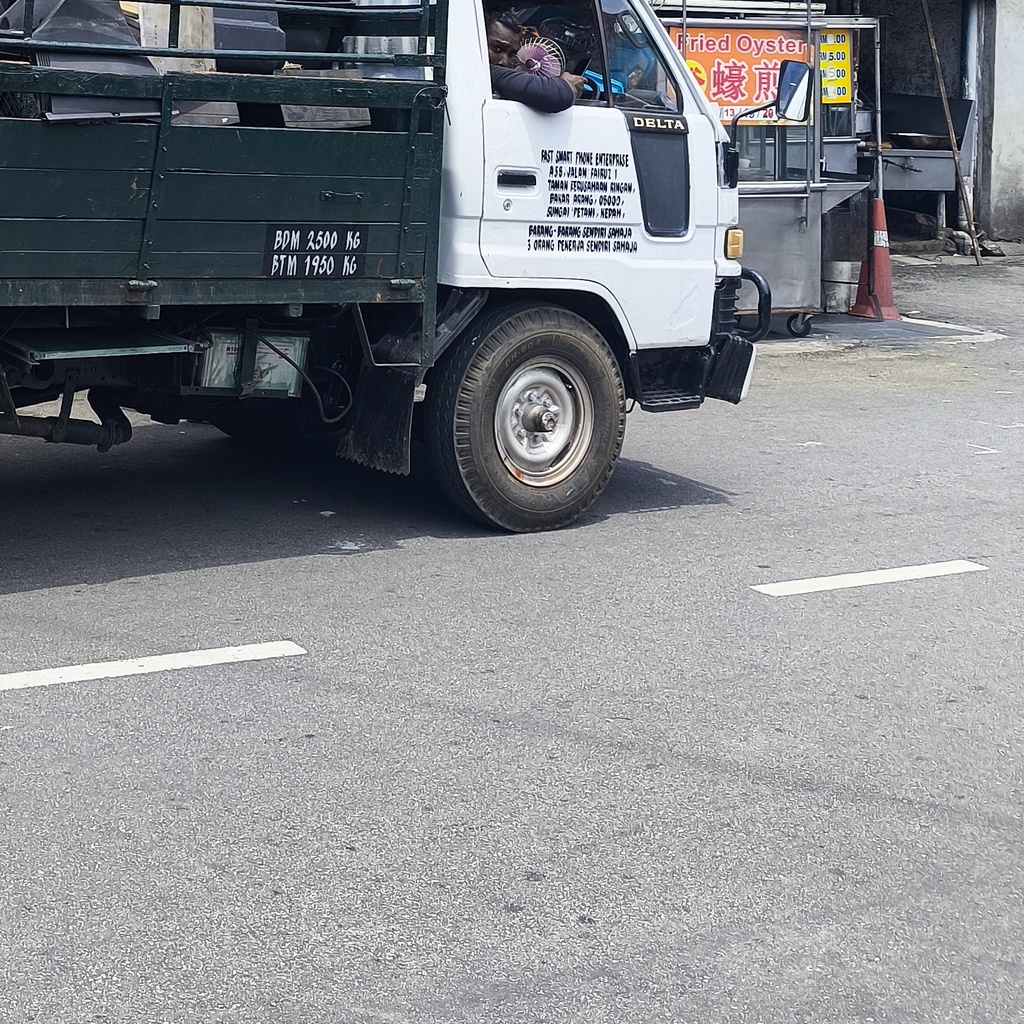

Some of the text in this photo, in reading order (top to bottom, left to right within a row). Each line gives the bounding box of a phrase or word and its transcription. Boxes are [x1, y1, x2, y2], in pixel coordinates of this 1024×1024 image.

[678, 34, 730, 53] Fried
[633, 117, 685, 130] DELTA
[541, 149, 629, 167] FAST SMART PHONE ENTERPRISE
[547, 179, 569, 192] TAMAN
[549, 193, 570, 204] BAKAR
[546, 206, 570, 218] SUNGAI
[582, 226, 607, 239] SENDIRI
[607, 227, 633, 239] SAHAJA
[274, 230, 361, 251] BDM 2500 KG
[533, 239, 555, 252] ORANG
[557, 240, 585, 253] PEKERJA
[586, 240, 611, 253] SENDIRI
[612, 241, 639, 254] SAHAJA
[270, 254, 357, 276] BTM 1950 KG
